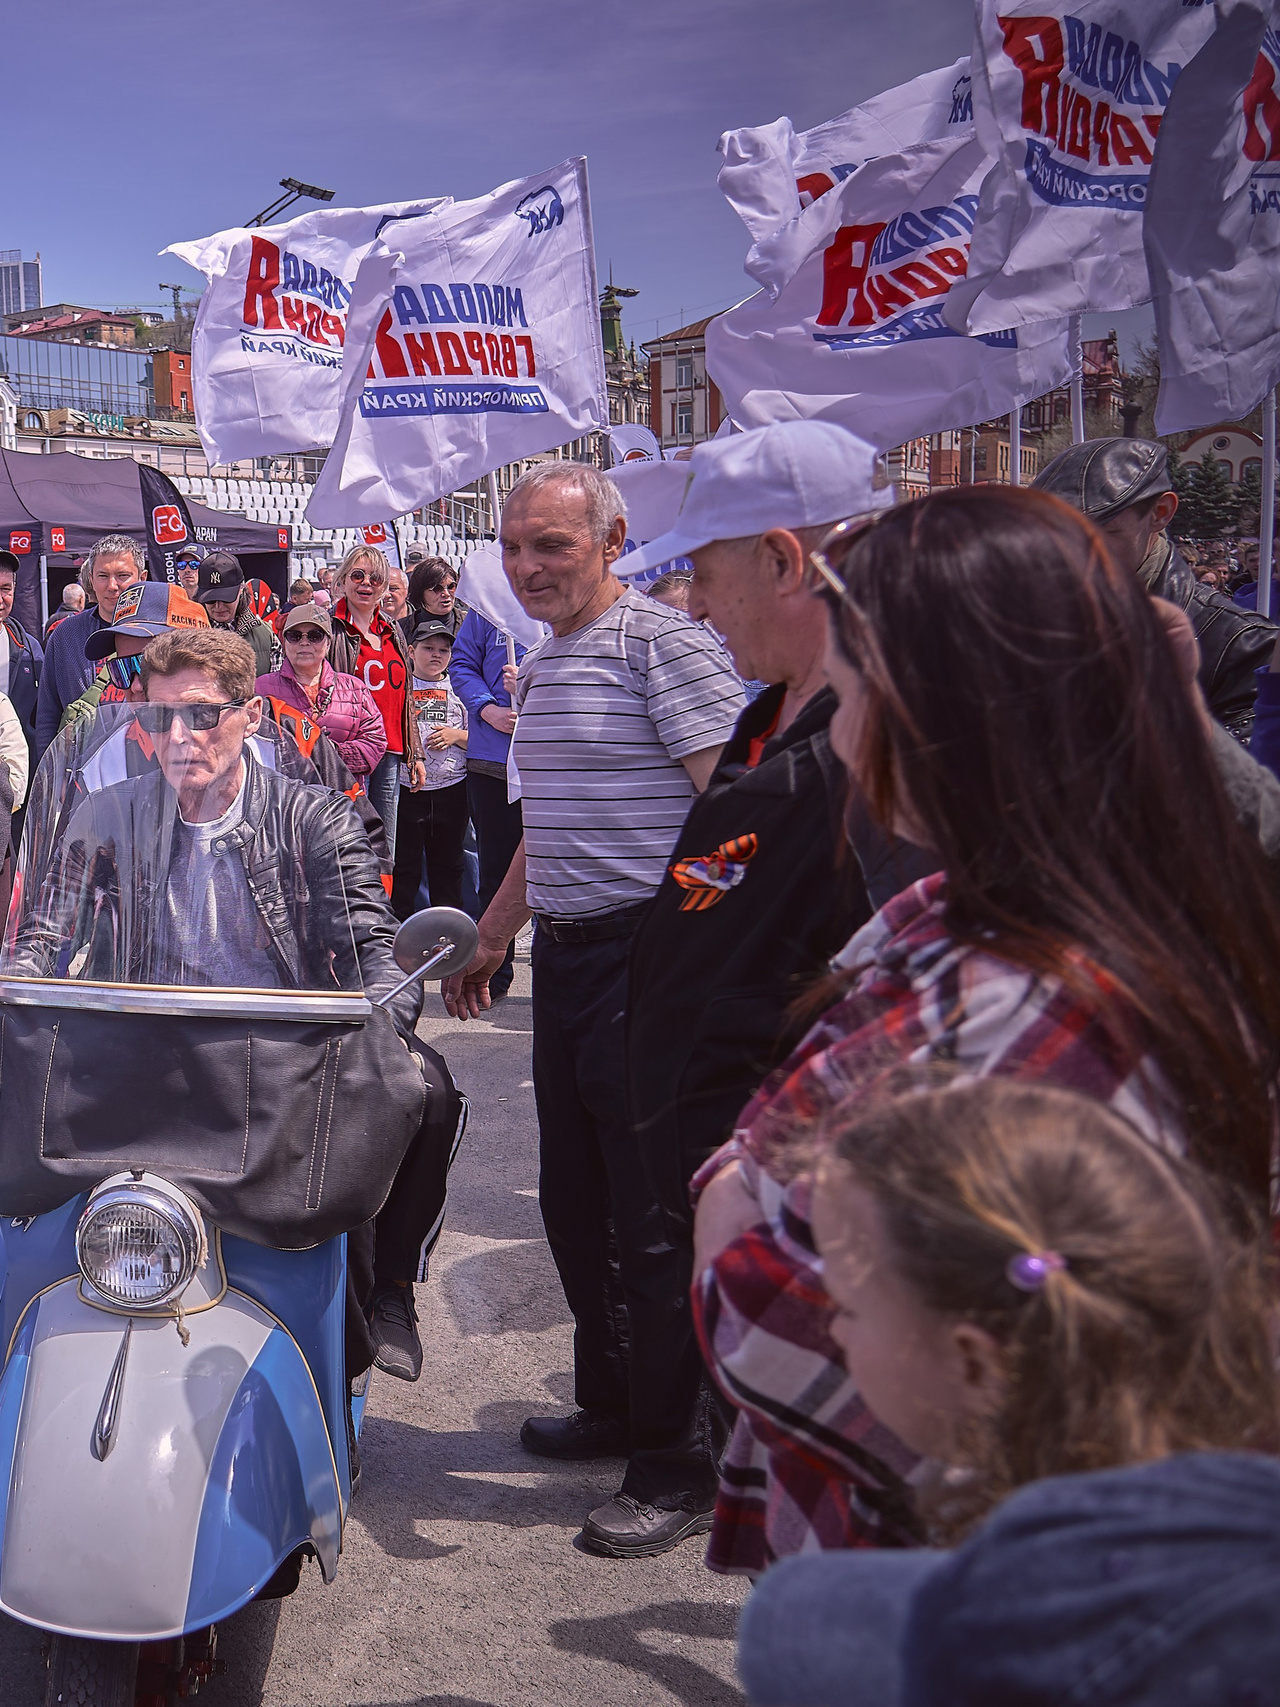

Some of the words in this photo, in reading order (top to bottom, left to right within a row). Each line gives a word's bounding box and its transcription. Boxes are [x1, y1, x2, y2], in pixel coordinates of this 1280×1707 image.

[156, 514, 185, 535] FQ
[10, 536, 29, 549] FQ
[51, 533, 65, 546] FQ
[278, 533, 288, 544] FQ
[164, 552, 176, 585] НОВО
[171, 614, 197, 627] RACING
